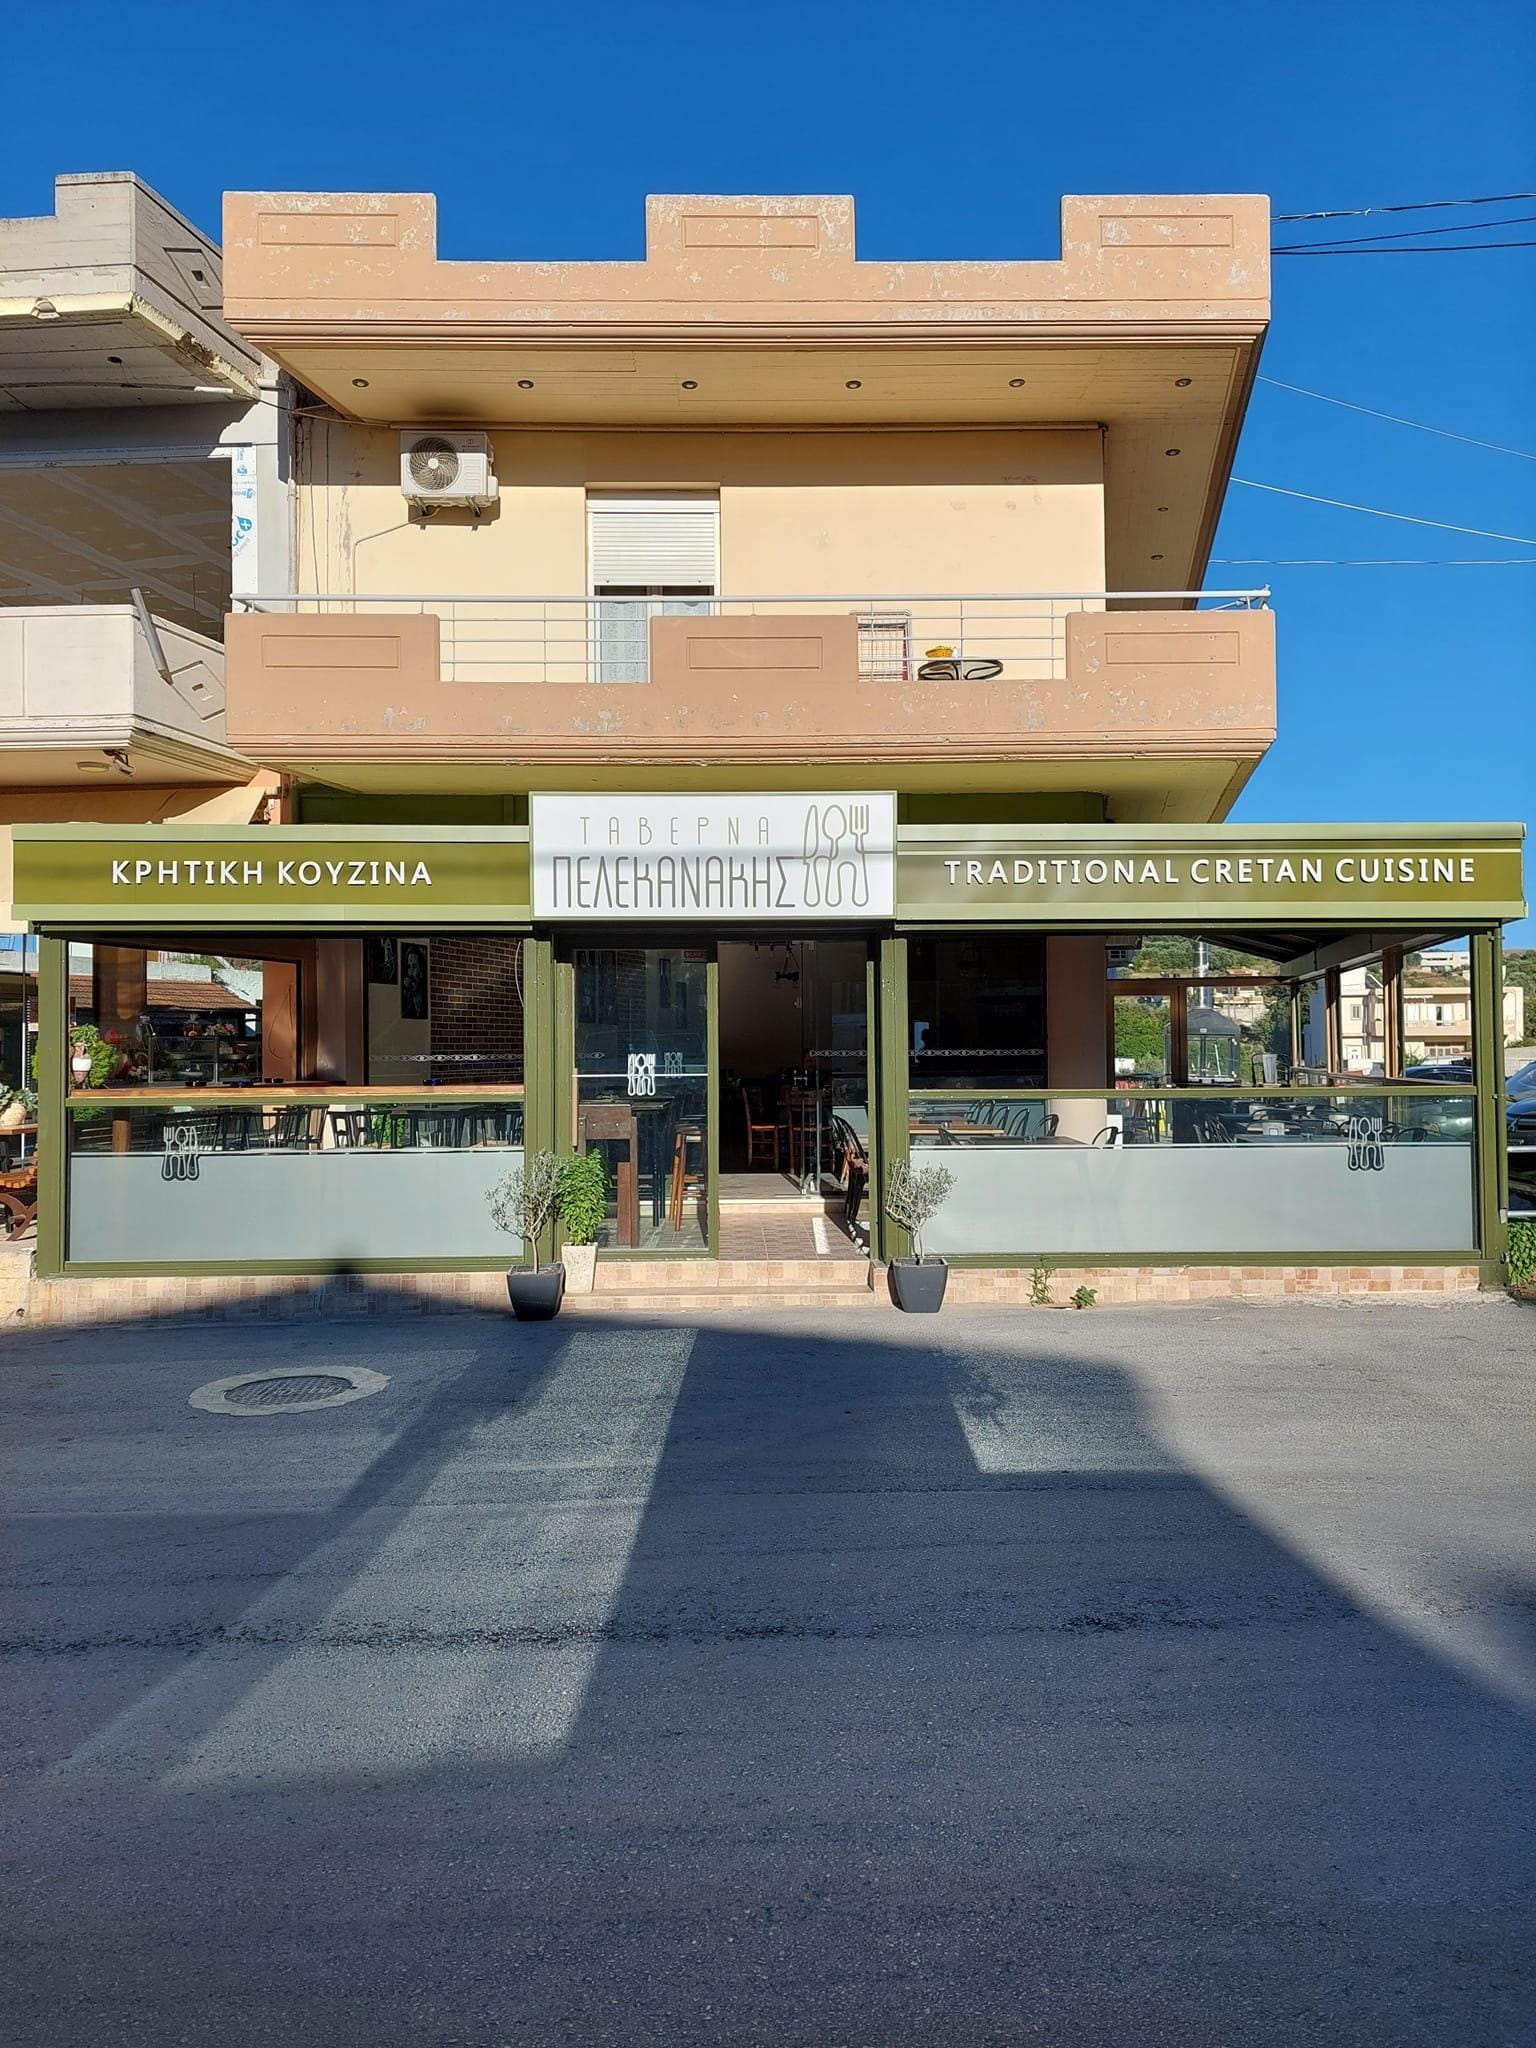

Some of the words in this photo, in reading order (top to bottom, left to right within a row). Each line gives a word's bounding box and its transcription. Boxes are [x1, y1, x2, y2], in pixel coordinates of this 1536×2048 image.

[580, 816, 769, 846] ΤΑΒΕΡΝΑ
[112, 861, 262, 884] ΚΡΗΤΙΚΗ
[278, 861, 432, 885] ΚΟΥΖΙΝΑ
[553, 856, 797, 908] ΠΕΛΕΚΑΝΑΚΗΣ
[944, 859, 1178, 885] TRADITIONAL
[1190, 858, 1323, 884] CRETAN
[1335, 858, 1475, 884] CUISINE
